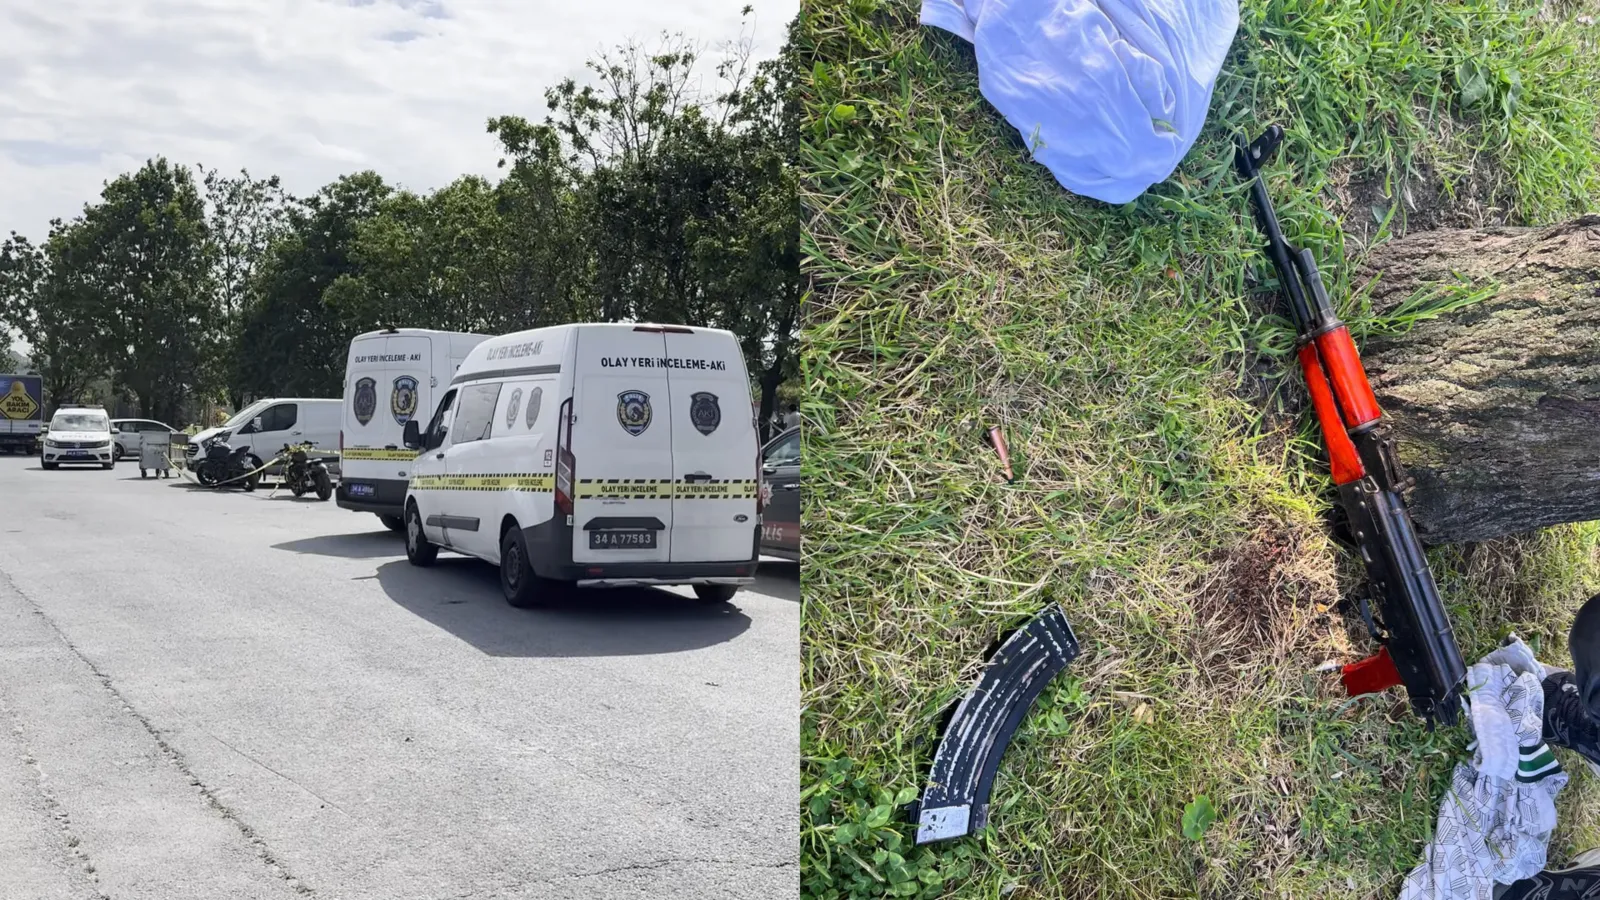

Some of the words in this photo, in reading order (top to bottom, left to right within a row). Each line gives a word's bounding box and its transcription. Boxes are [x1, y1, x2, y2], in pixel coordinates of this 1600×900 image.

[601, 357, 628, 368] OLAY
[601, 485, 616, 493] OLAY
[676, 485, 690, 493] OLAY
[595, 534, 608, 544] 34
[611, 534, 617, 544] A
[620, 534, 651, 544] 77583
